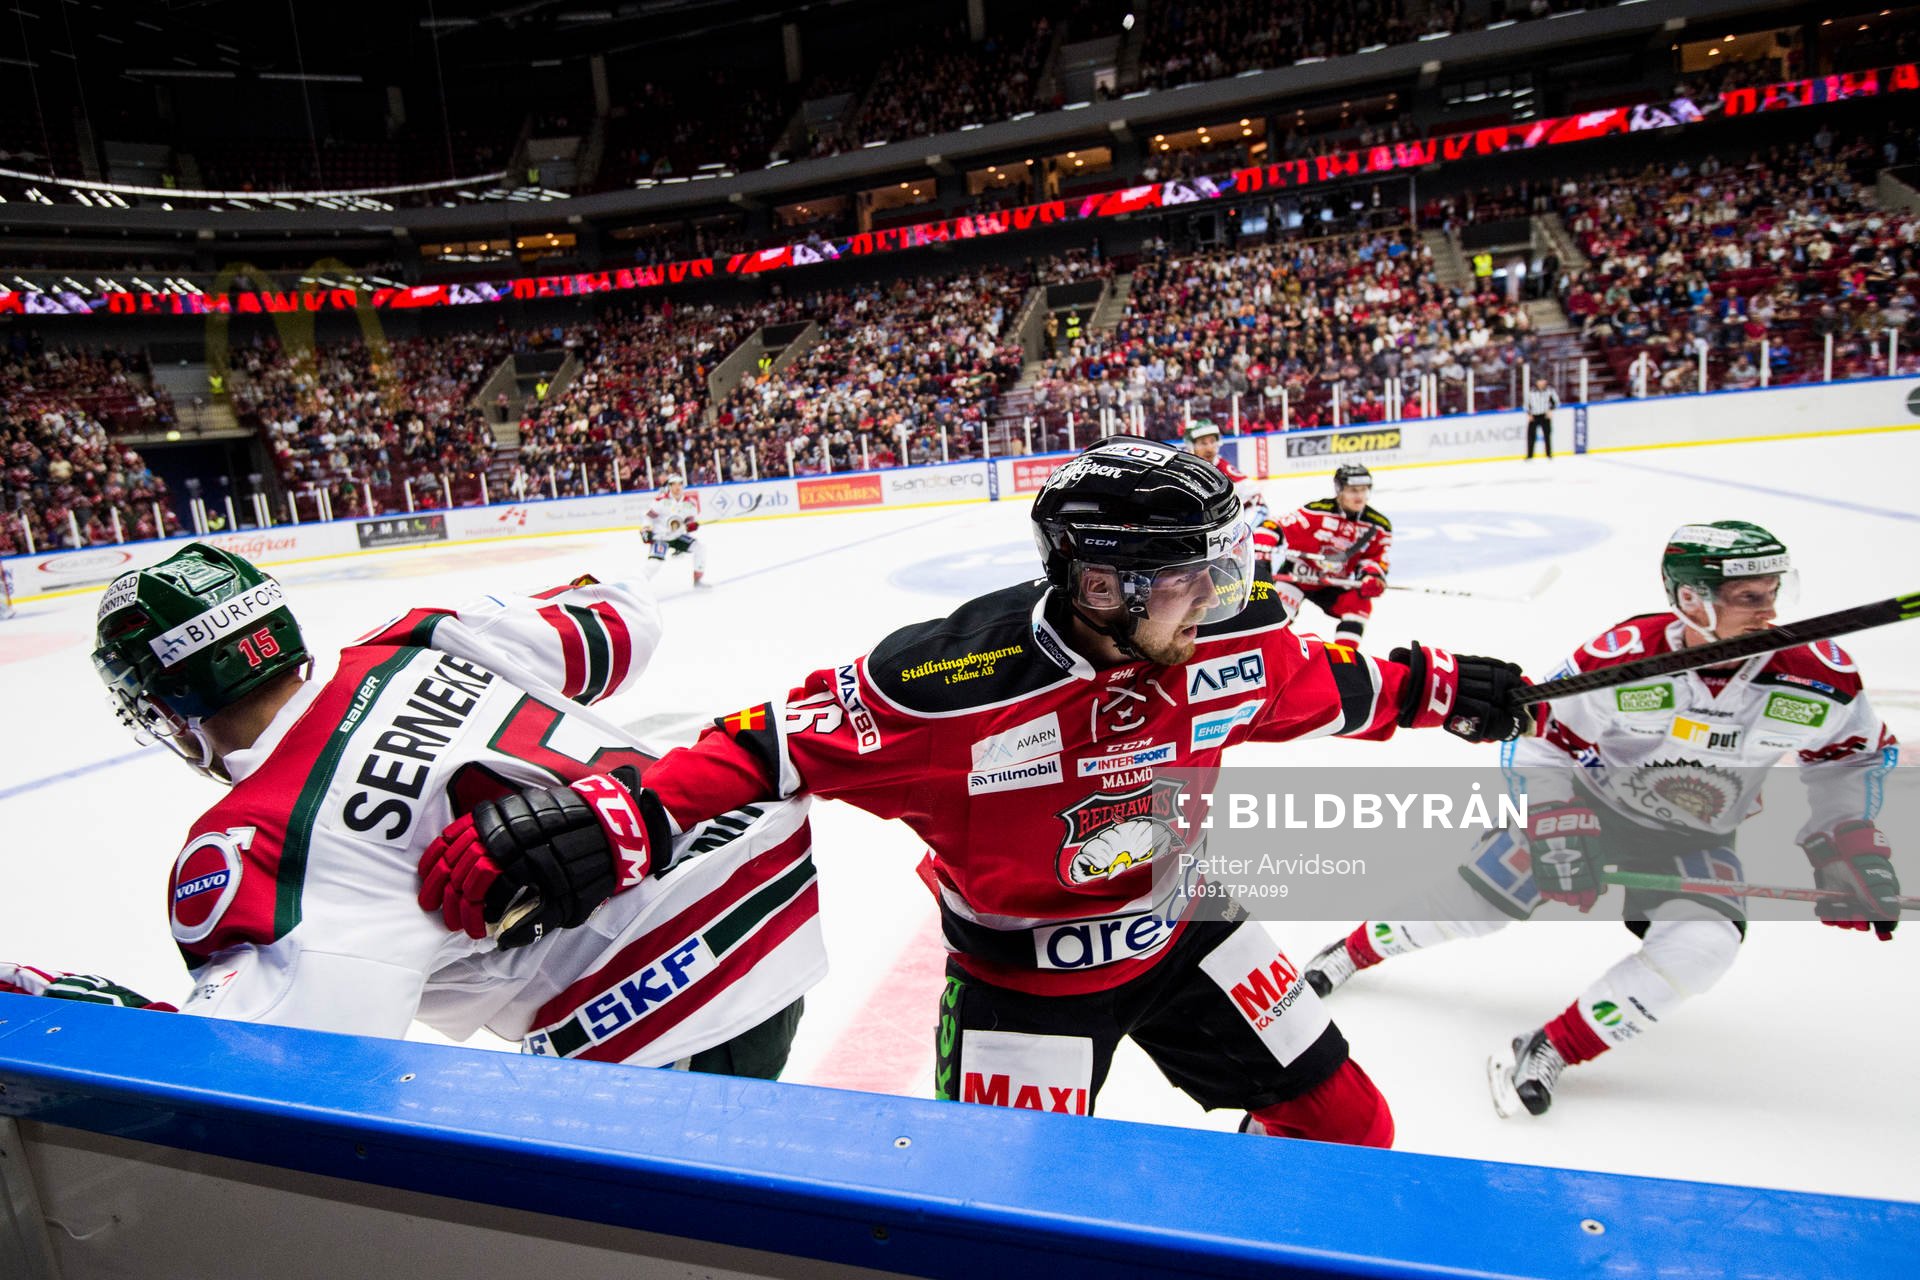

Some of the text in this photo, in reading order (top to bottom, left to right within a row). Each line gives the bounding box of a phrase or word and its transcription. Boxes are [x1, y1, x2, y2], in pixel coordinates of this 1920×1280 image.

[1084, 537, 1119, 548] CCM
[238, 626, 280, 667] 15
[901, 644, 1024, 683] Ställningsbyggarna
[981, 667, 995, 677] AB
[1108, 667, 1135, 683] SHL
[342, 654, 495, 841] SERNEKE
[1016, 728, 1056, 751] AVARN
[1106, 737, 1153, 753] CCM
[1098, 746, 1171, 771] INTERSPORT
[986, 761, 1058, 784] Tillmobil
[1102, 766, 1154, 790] MALMÖ
[570, 774, 648, 887] CCM
[176, 873, 227, 899] VOLVO
[583, 936, 701, 1041] SKF
[1255, 1015, 1274, 1032] ICA
[963, 1071, 1087, 1117] MAXI
